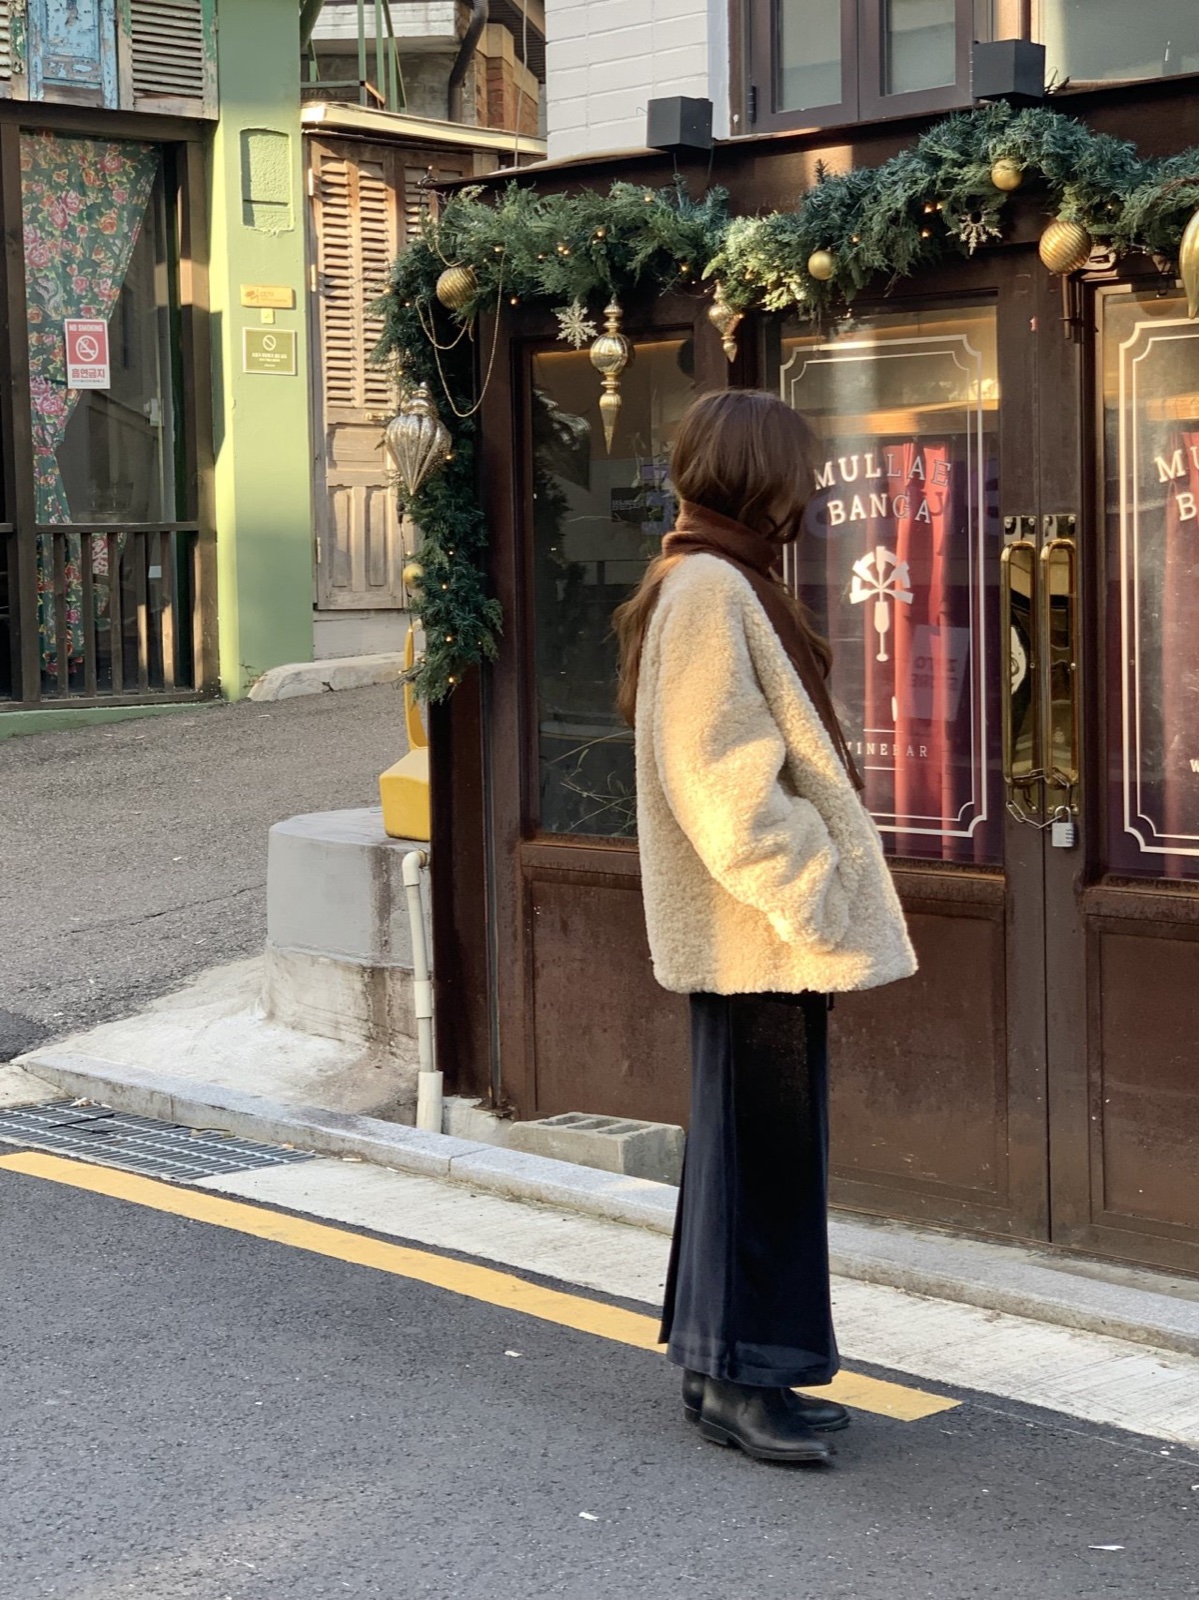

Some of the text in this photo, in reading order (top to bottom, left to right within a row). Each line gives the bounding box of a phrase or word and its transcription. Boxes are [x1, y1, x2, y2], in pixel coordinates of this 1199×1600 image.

[78, 324, 103, 332] SMOKING
[71, 368, 105, 378] 흡연금지
[813, 453, 951, 490] MULLAE
[827, 493, 931, 526] BANGA
